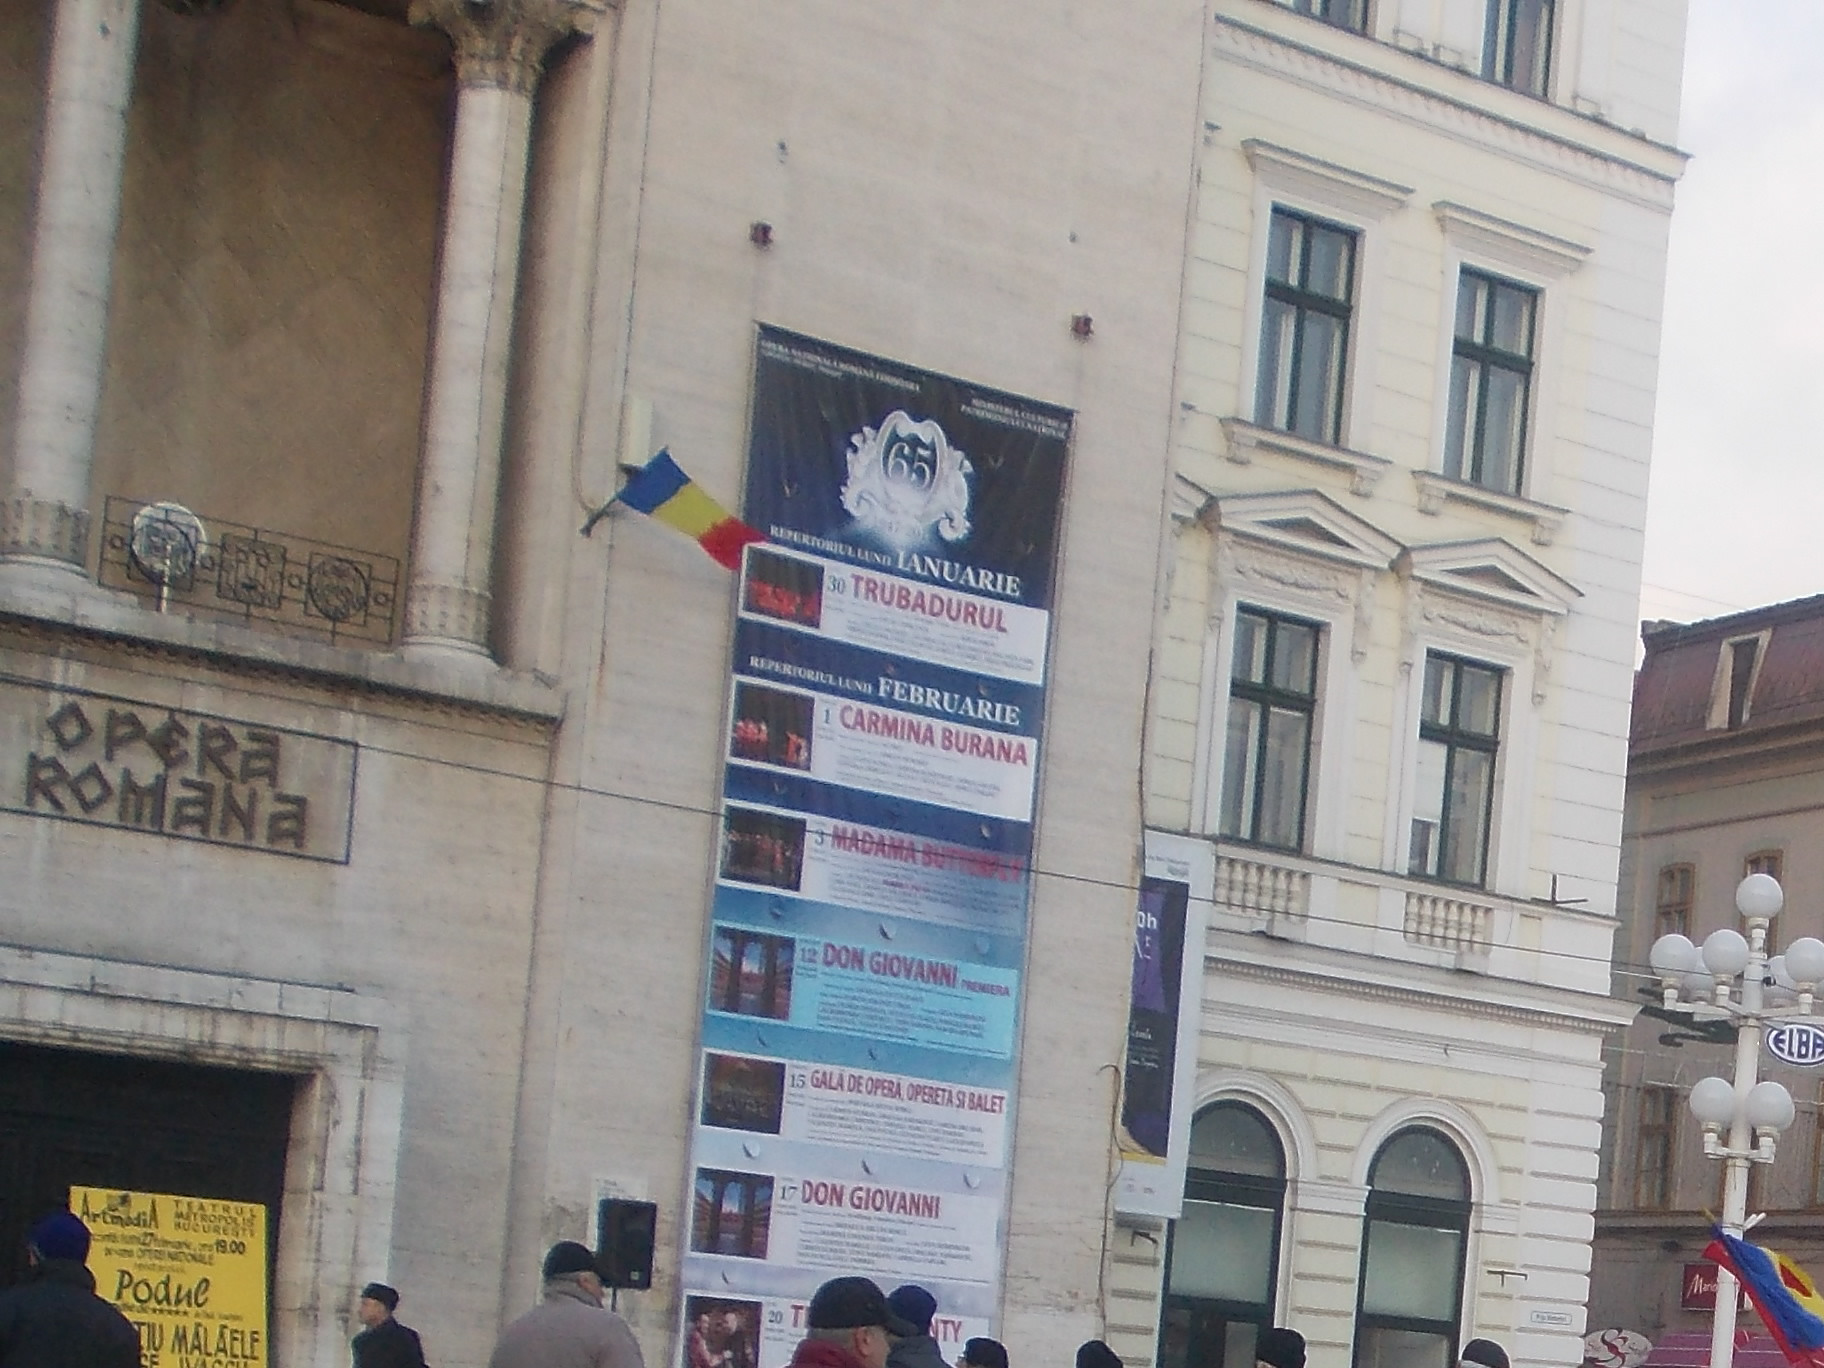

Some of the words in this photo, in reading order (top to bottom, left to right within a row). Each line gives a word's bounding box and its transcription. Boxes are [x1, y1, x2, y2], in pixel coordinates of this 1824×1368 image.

[888, 442, 931, 489] 65
[770, 524, 854, 557] REPERTORIUL
[897, 550, 1020, 597] IANUARIE
[827, 575, 847, 595] 30
[851, 574, 1008, 633] TRUBADURUL
[750, 655, 837, 686] REPERTORIUL
[878, 676, 1021, 726] FEBRUARIE
[46, 701, 281, 788] OPERA
[839, 704, 936, 749] CARMINA
[940, 729, 1029, 766] BURANA
[830, 824, 918, 865] MADAMA
[800, 947, 818, 964] 12
[822, 942, 865, 974] DON
[869, 950, 959, 990] GIOVANNI
[790, 1074, 806, 1089] 15
[847, 1074, 865, 1094] DE
[967, 1092, 1006, 1114] BALET
[174, 1200, 258, 1218] TEATRUL
[174, 1211, 258, 1228] METROPOLIS
[780, 1185, 797, 1201] 17
[802, 1180, 846, 1208] DON
[849, 1186, 941, 1219] GIOVANNI
[216, 1238, 247, 1255] 19.00
[114, 1269, 211, 1308] Podul
[768, 1310, 783, 1324] 20
